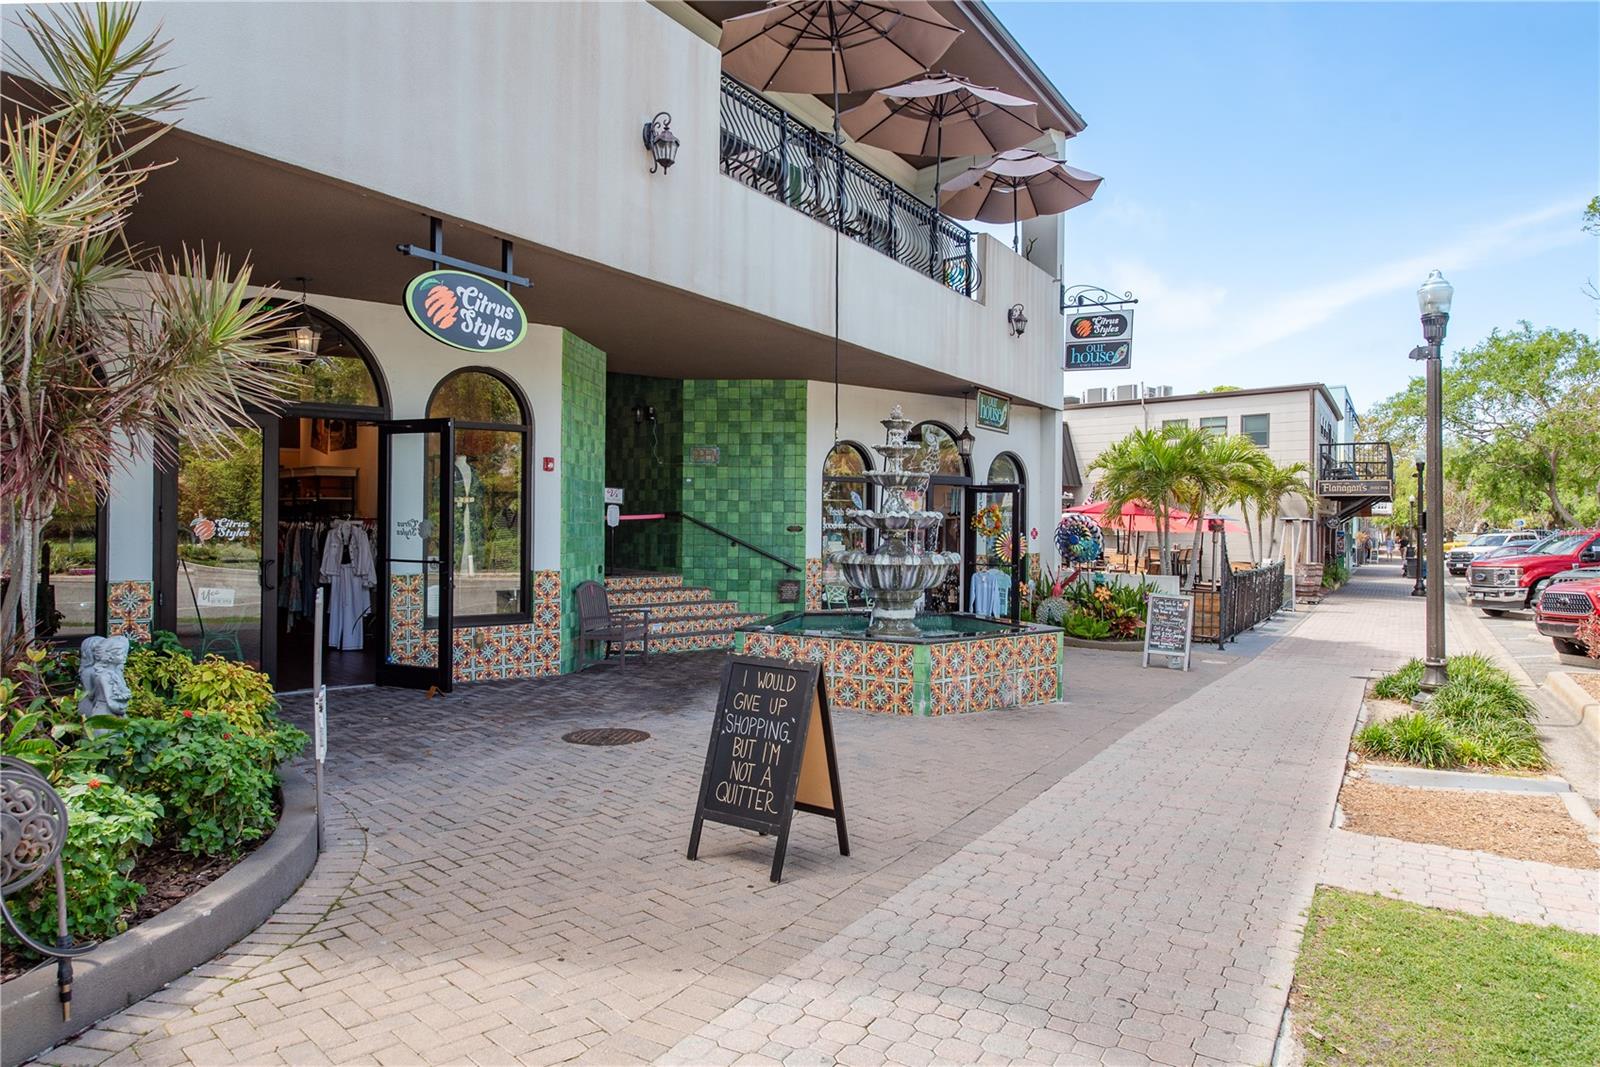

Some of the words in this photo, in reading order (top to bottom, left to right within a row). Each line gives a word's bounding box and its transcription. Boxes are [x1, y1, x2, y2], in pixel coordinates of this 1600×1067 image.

[456, 286, 514, 320] Citrus
[460, 309, 514, 347] Styles
[1092, 316, 1119, 327] Citrus
[1094, 324, 1119, 336] Styles
[1070, 348, 1115, 364] house
[1086, 344, 1106, 352] our
[1321, 482, 1367, 493] Flanagan's
[215, 518, 250, 528] Citrus
[217, 526, 250, 541] Styles
[743, 670, 748, 687] I
[757, 671, 797, 693] WOULD
[769, 697, 788, 716] UP
[732, 736, 757, 758] BUT
[762, 741, 781, 767] I'M
[729, 760, 756, 782] NOT
[760, 766, 772, 788] A
[715, 781, 778, 814] QUITTER
